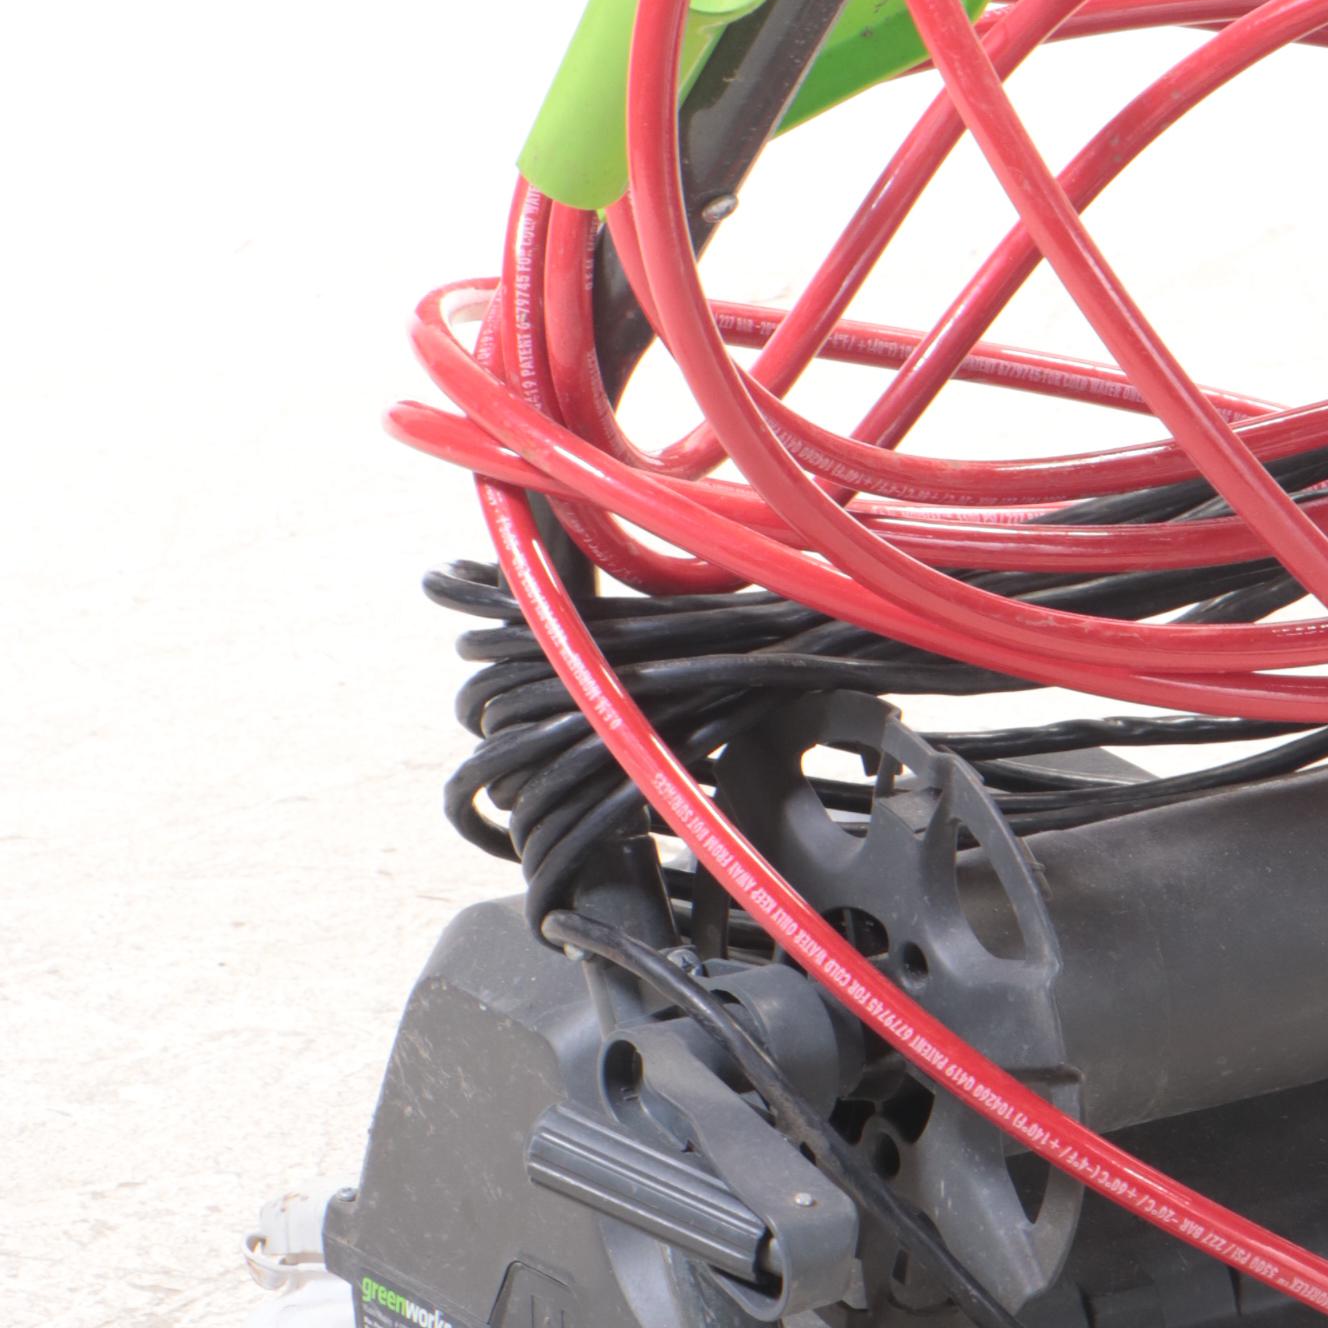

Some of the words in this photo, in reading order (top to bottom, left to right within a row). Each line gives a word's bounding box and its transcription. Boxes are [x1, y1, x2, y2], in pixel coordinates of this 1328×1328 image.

[651, 772, 693, 823] SURFACES
[686, 816, 710, 842] HOT
[703, 835, 736, 867] FROM
[728, 860, 757, 890] AWAY
[749, 886, 778, 913] KEEP
[770, 906, 799, 936] ONLY
[793, 929, 828, 965] WATER
[824, 959, 852, 987] COLD
[848, 980, 871, 1004] FOR
[867, 997, 914, 1040] 6779745
[909, 1035, 949, 1070] PATENT
[945, 1064, 976, 1091] 0419
[972, 1084, 1015, 1120] 104260
[1180, 1218, 1204, 1239] BAR
[1202, 1232, 1227, 1251] 227
